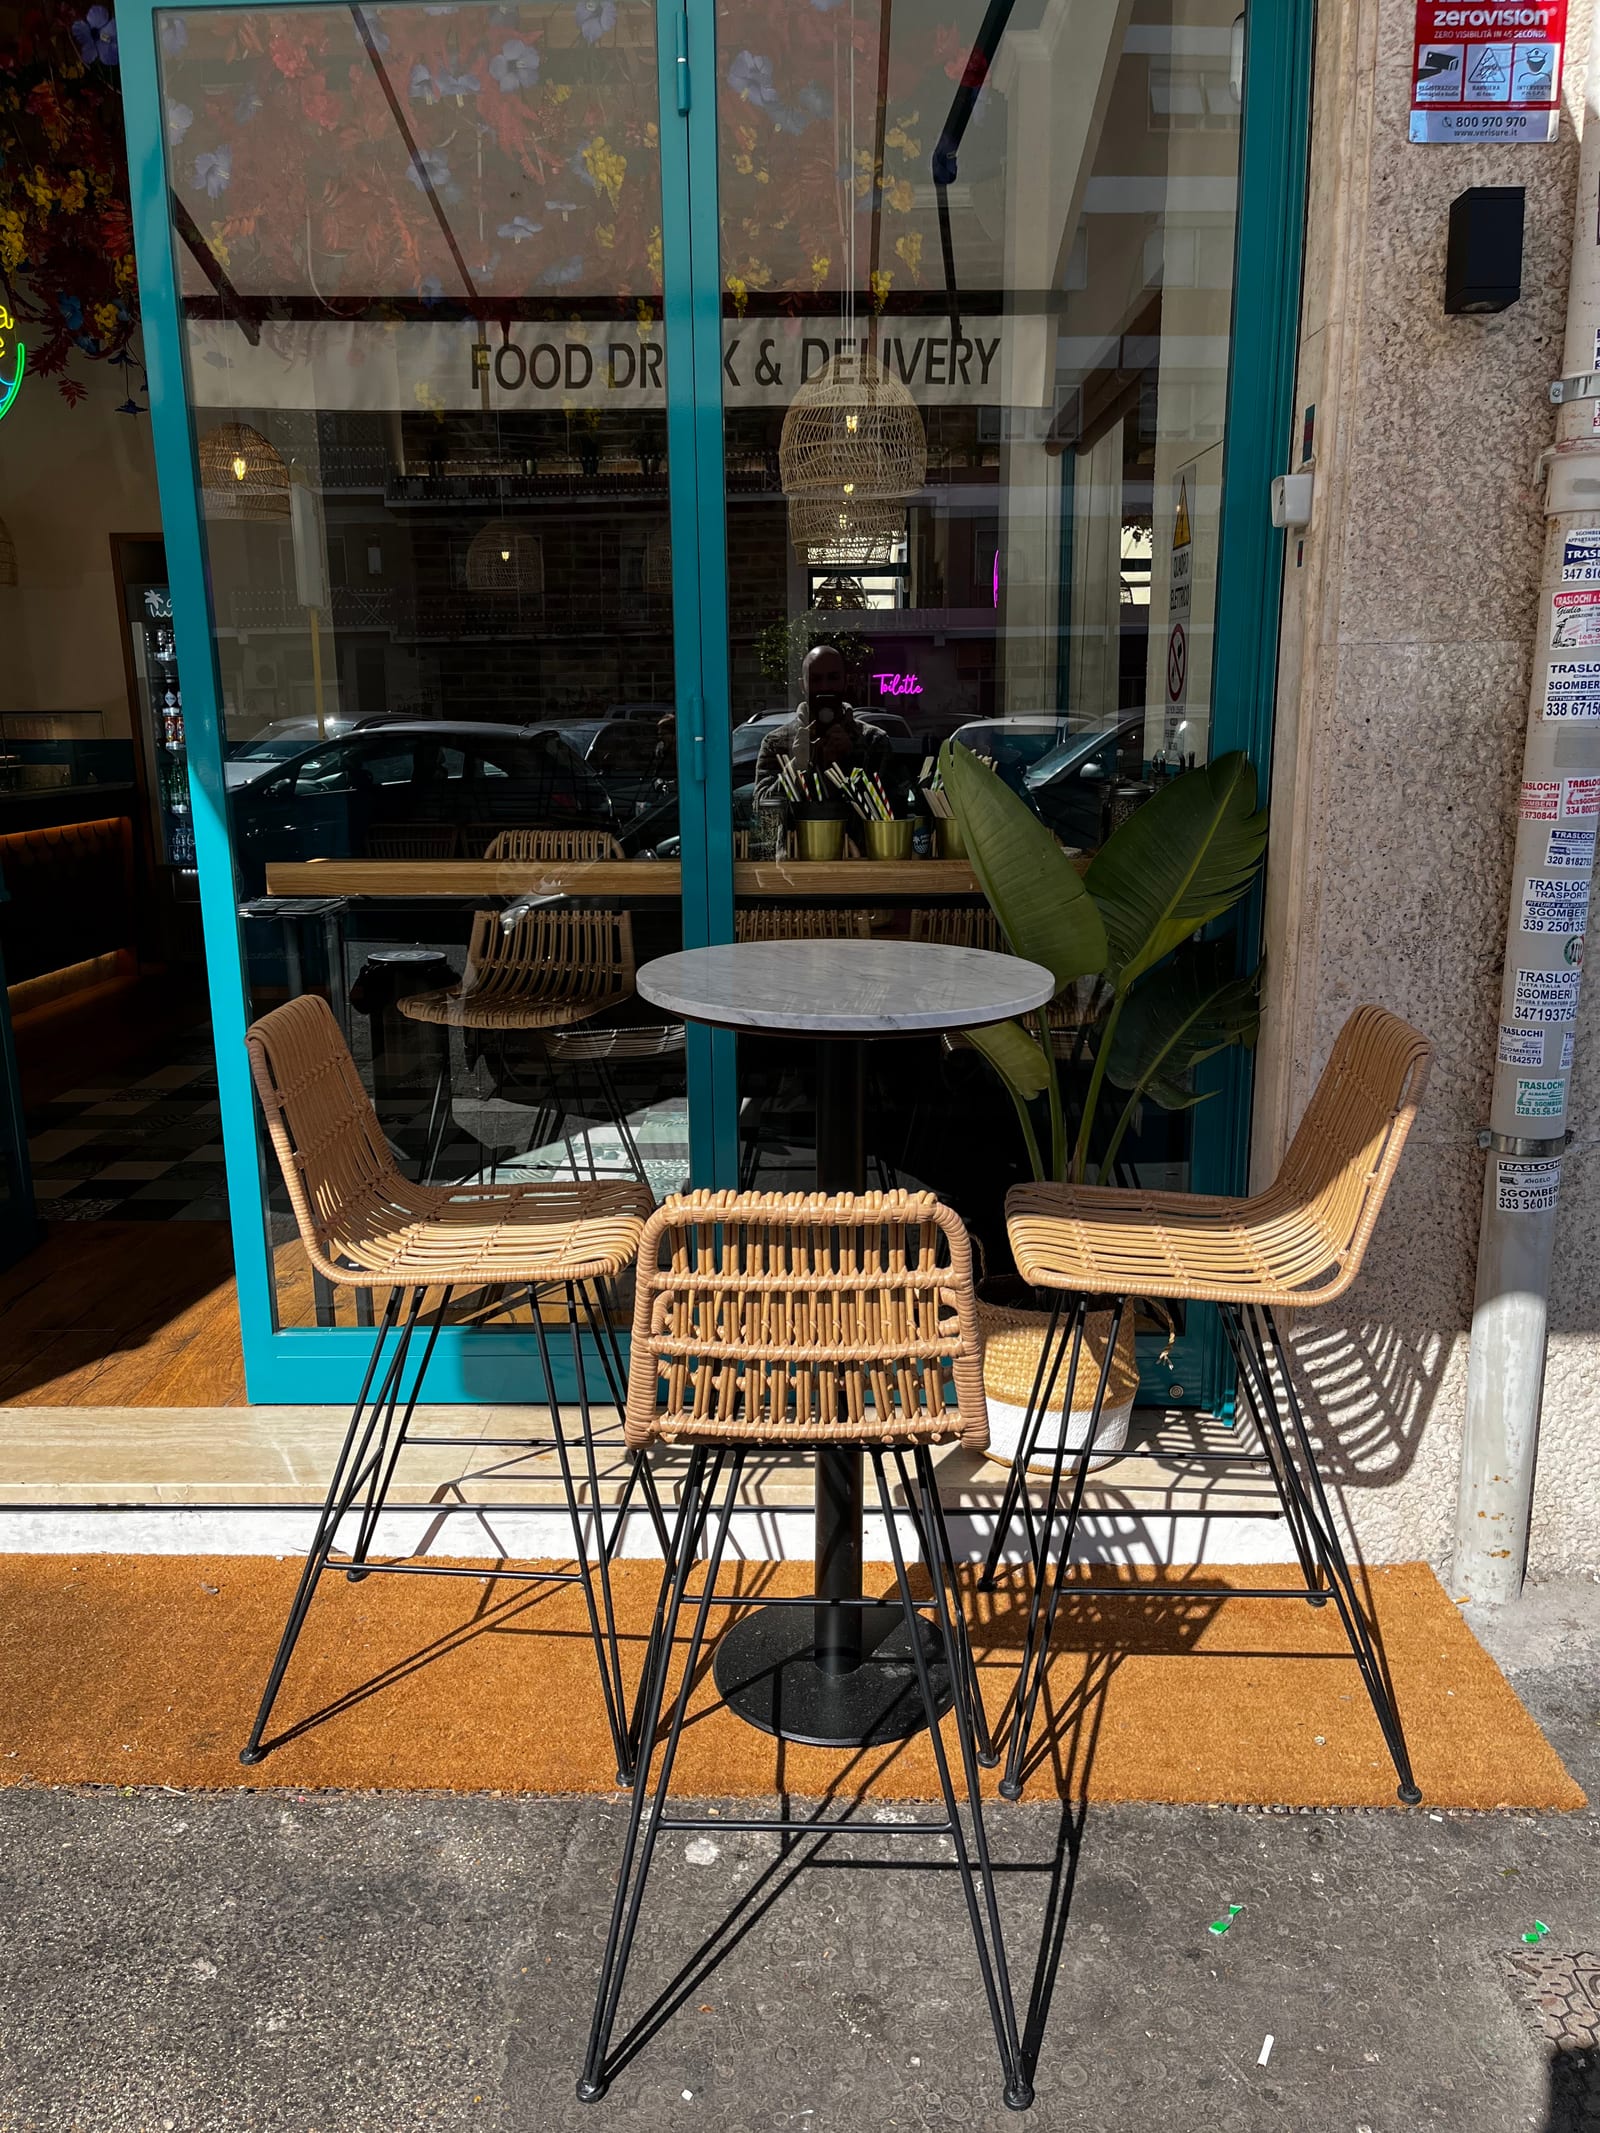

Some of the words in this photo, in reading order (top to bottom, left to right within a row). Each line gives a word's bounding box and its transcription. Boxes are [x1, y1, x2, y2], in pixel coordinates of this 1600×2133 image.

[1434, 9, 1549, 27] zerovision
[1434, 31, 1453, 39] ZERO
[1456, 29, 1492, 39] VISIBILITÀ
[1494, 30, 1501, 38] IN
[1514, 29, 1547, 38] SECONDI
[1456, 117, 1478, 127] 800
[1482, 117, 1502, 127] 970
[1505, 117, 1527, 127] 970
[1454, 128, 1518, 137] www.verisure.it
[471, 343, 593, 390] FOOD
[754, 338, 784, 386] &
[801, 336, 1001, 386] DELIVERY
[1174, 551, 1189, 578] QUADRO
[1563, 568, 1582, 580] 347
[1170, 583, 1190, 610] ELETTRICO
[872, 673, 924, 696] Toilette
[1546, 702, 1568, 716] 338
[1525, 811, 1557, 819] 5730844
[1566, 806, 1580, 815] 334
[1547, 856, 1564, 865] 320
[1523, 919, 1544, 931] 339
[1516, 987, 1572, 1000] SGOMBERI
[1500, 1026, 1543, 1037] TRASLOCHI
[1509, 1055, 1542, 1065] 1842570
[1499, 1197, 1519, 1210] 333
